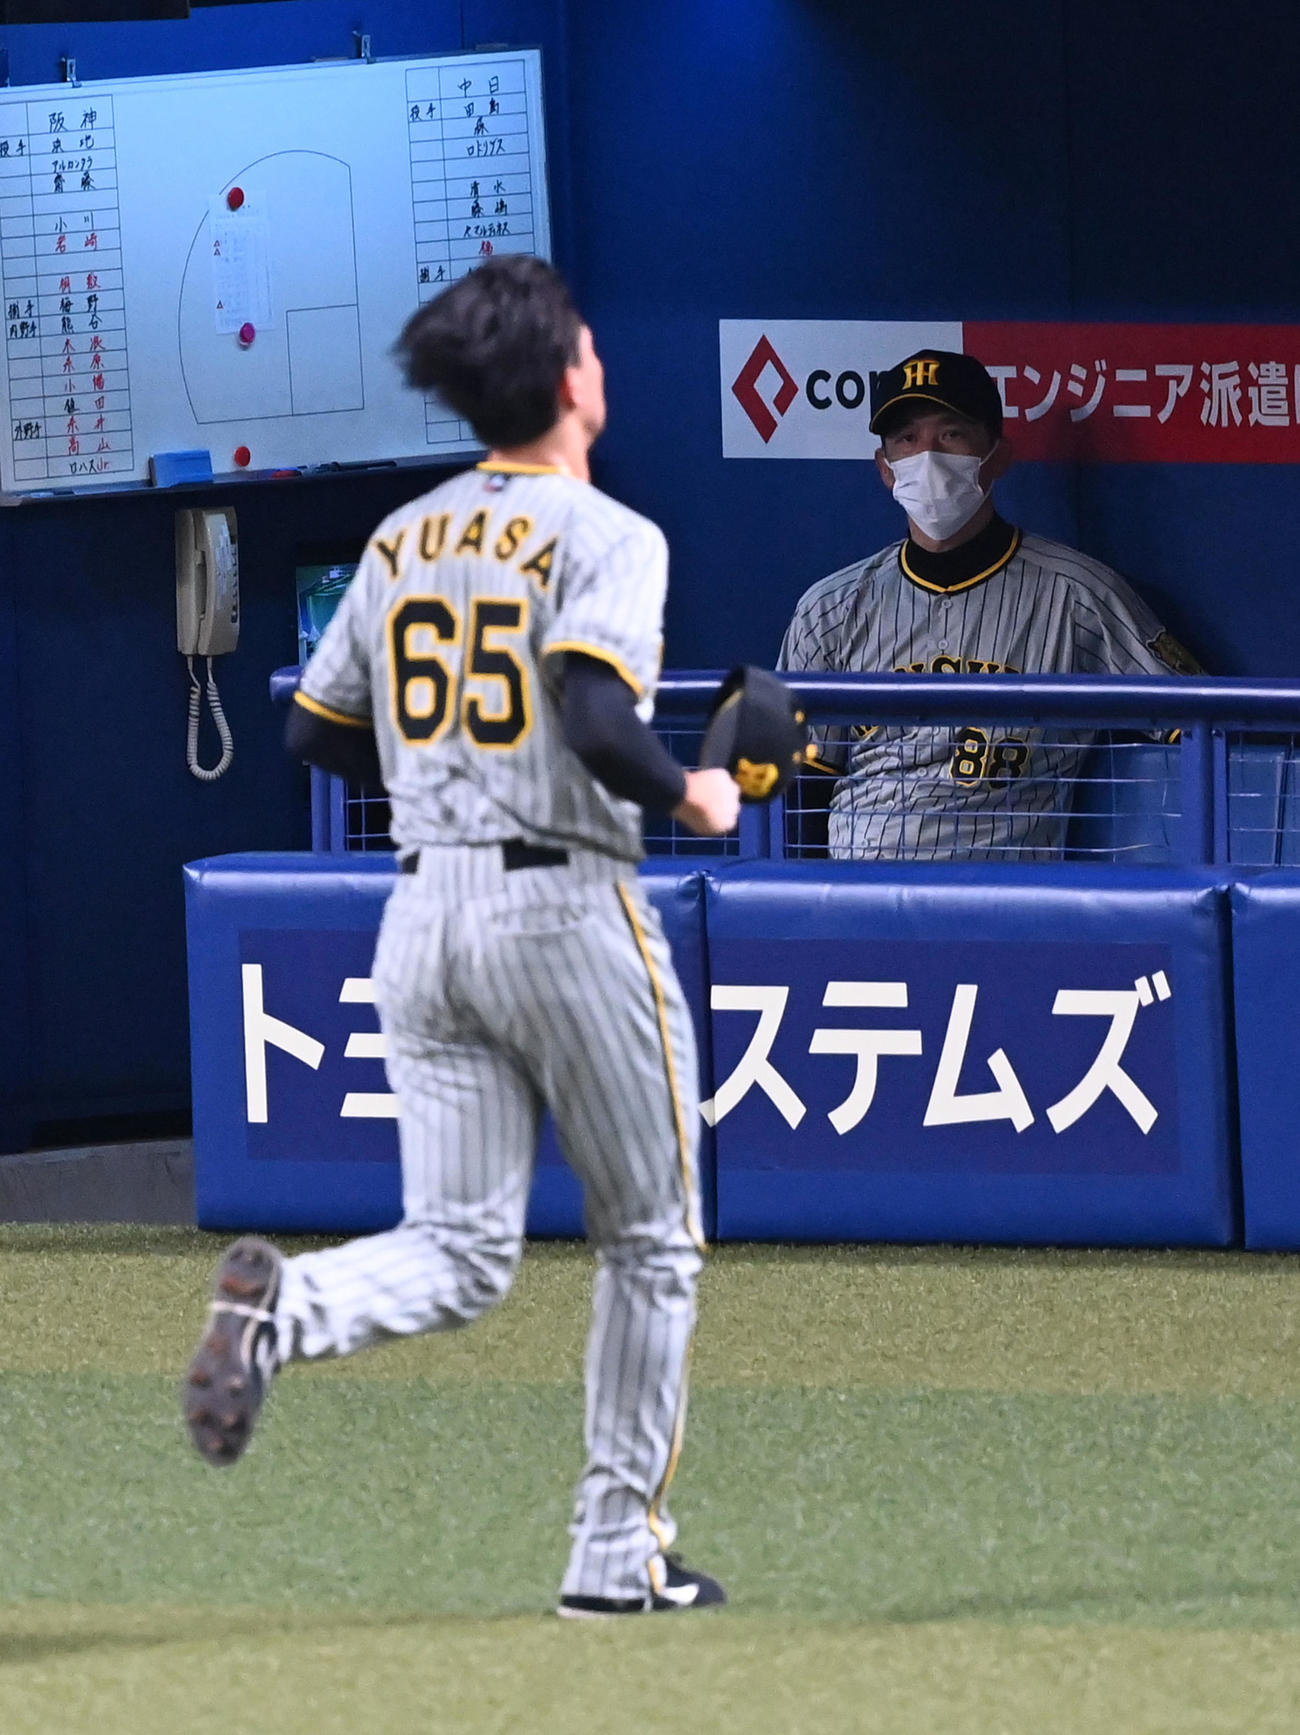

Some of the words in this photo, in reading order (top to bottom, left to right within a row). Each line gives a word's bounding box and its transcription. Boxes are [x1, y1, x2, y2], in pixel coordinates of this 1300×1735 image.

[48, 107, 98, 133] 阪神
[457, 75, 499, 98] 中日
[985, 359, 1300, 428] エンジニア派遣
[374, 508, 559, 591] YUASA
[385, 593, 534, 750] 65
[949, 725, 1031, 790] 88
